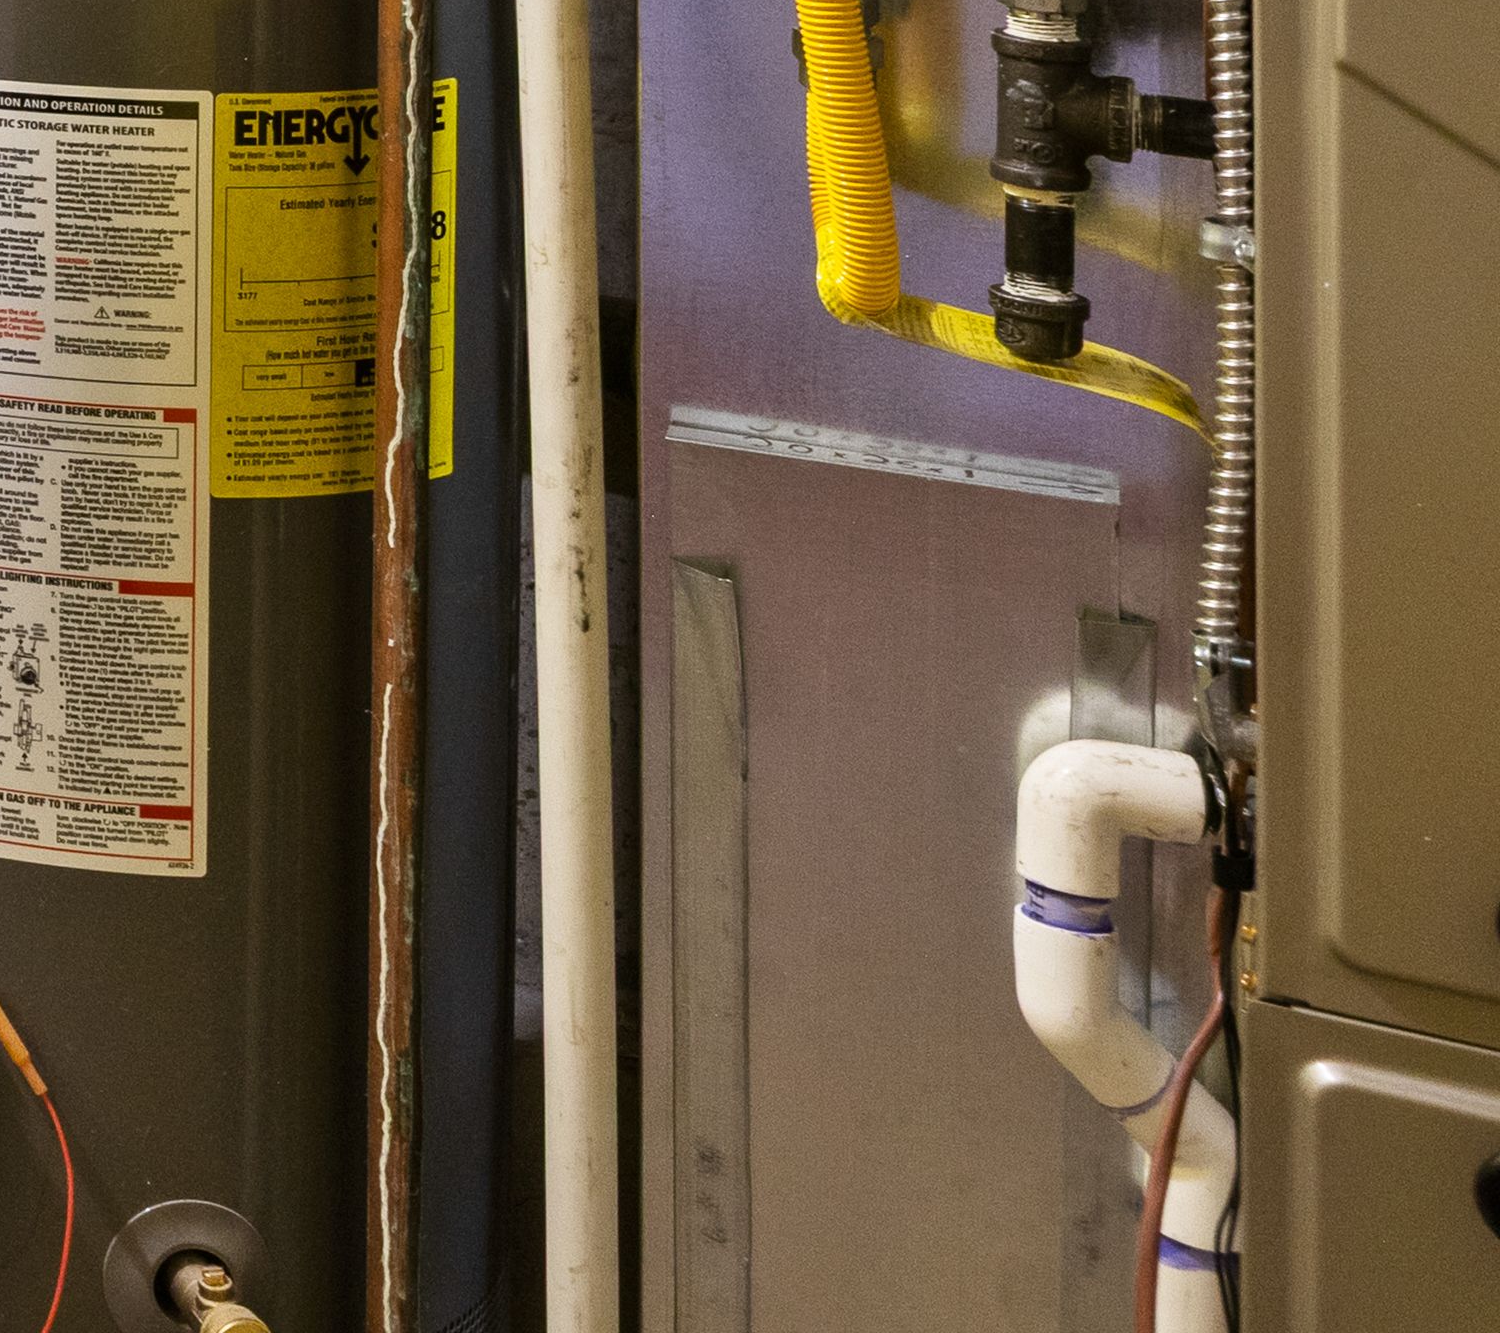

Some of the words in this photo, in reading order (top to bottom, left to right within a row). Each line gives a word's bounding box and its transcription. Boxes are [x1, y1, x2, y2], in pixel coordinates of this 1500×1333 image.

[24, 99, 48, 109] AND
[50, 101, 116, 114] OPERATION
[118, 105, 164, 115] DETAILS
[17, 120, 68, 133] STORAGE
[71, 123, 110, 135] WATER
[112, 126, 155, 136] HEATER
[280, 198, 325, 210] Estimated
[328, 197, 355, 208] Yearly
[316, 336, 337, 346] First
[0, 399, 35, 412] SAFETY
[38, 402, 63, 414] READ
[66, 405, 101, 417] BEFORE
[104, 408, 156, 421] OPERATING
[0, 571, 42, 585] LIGHTING
[45, 576, 113, 591] INSTRUCTIONS
[6, 792, 24, 804] GAS
[27, 795, 46, 807] OFF
[49, 799, 61, 809] TO
[64, 801, 81, 811] THE
[84, 803, 135, 816] APPLIANCE
